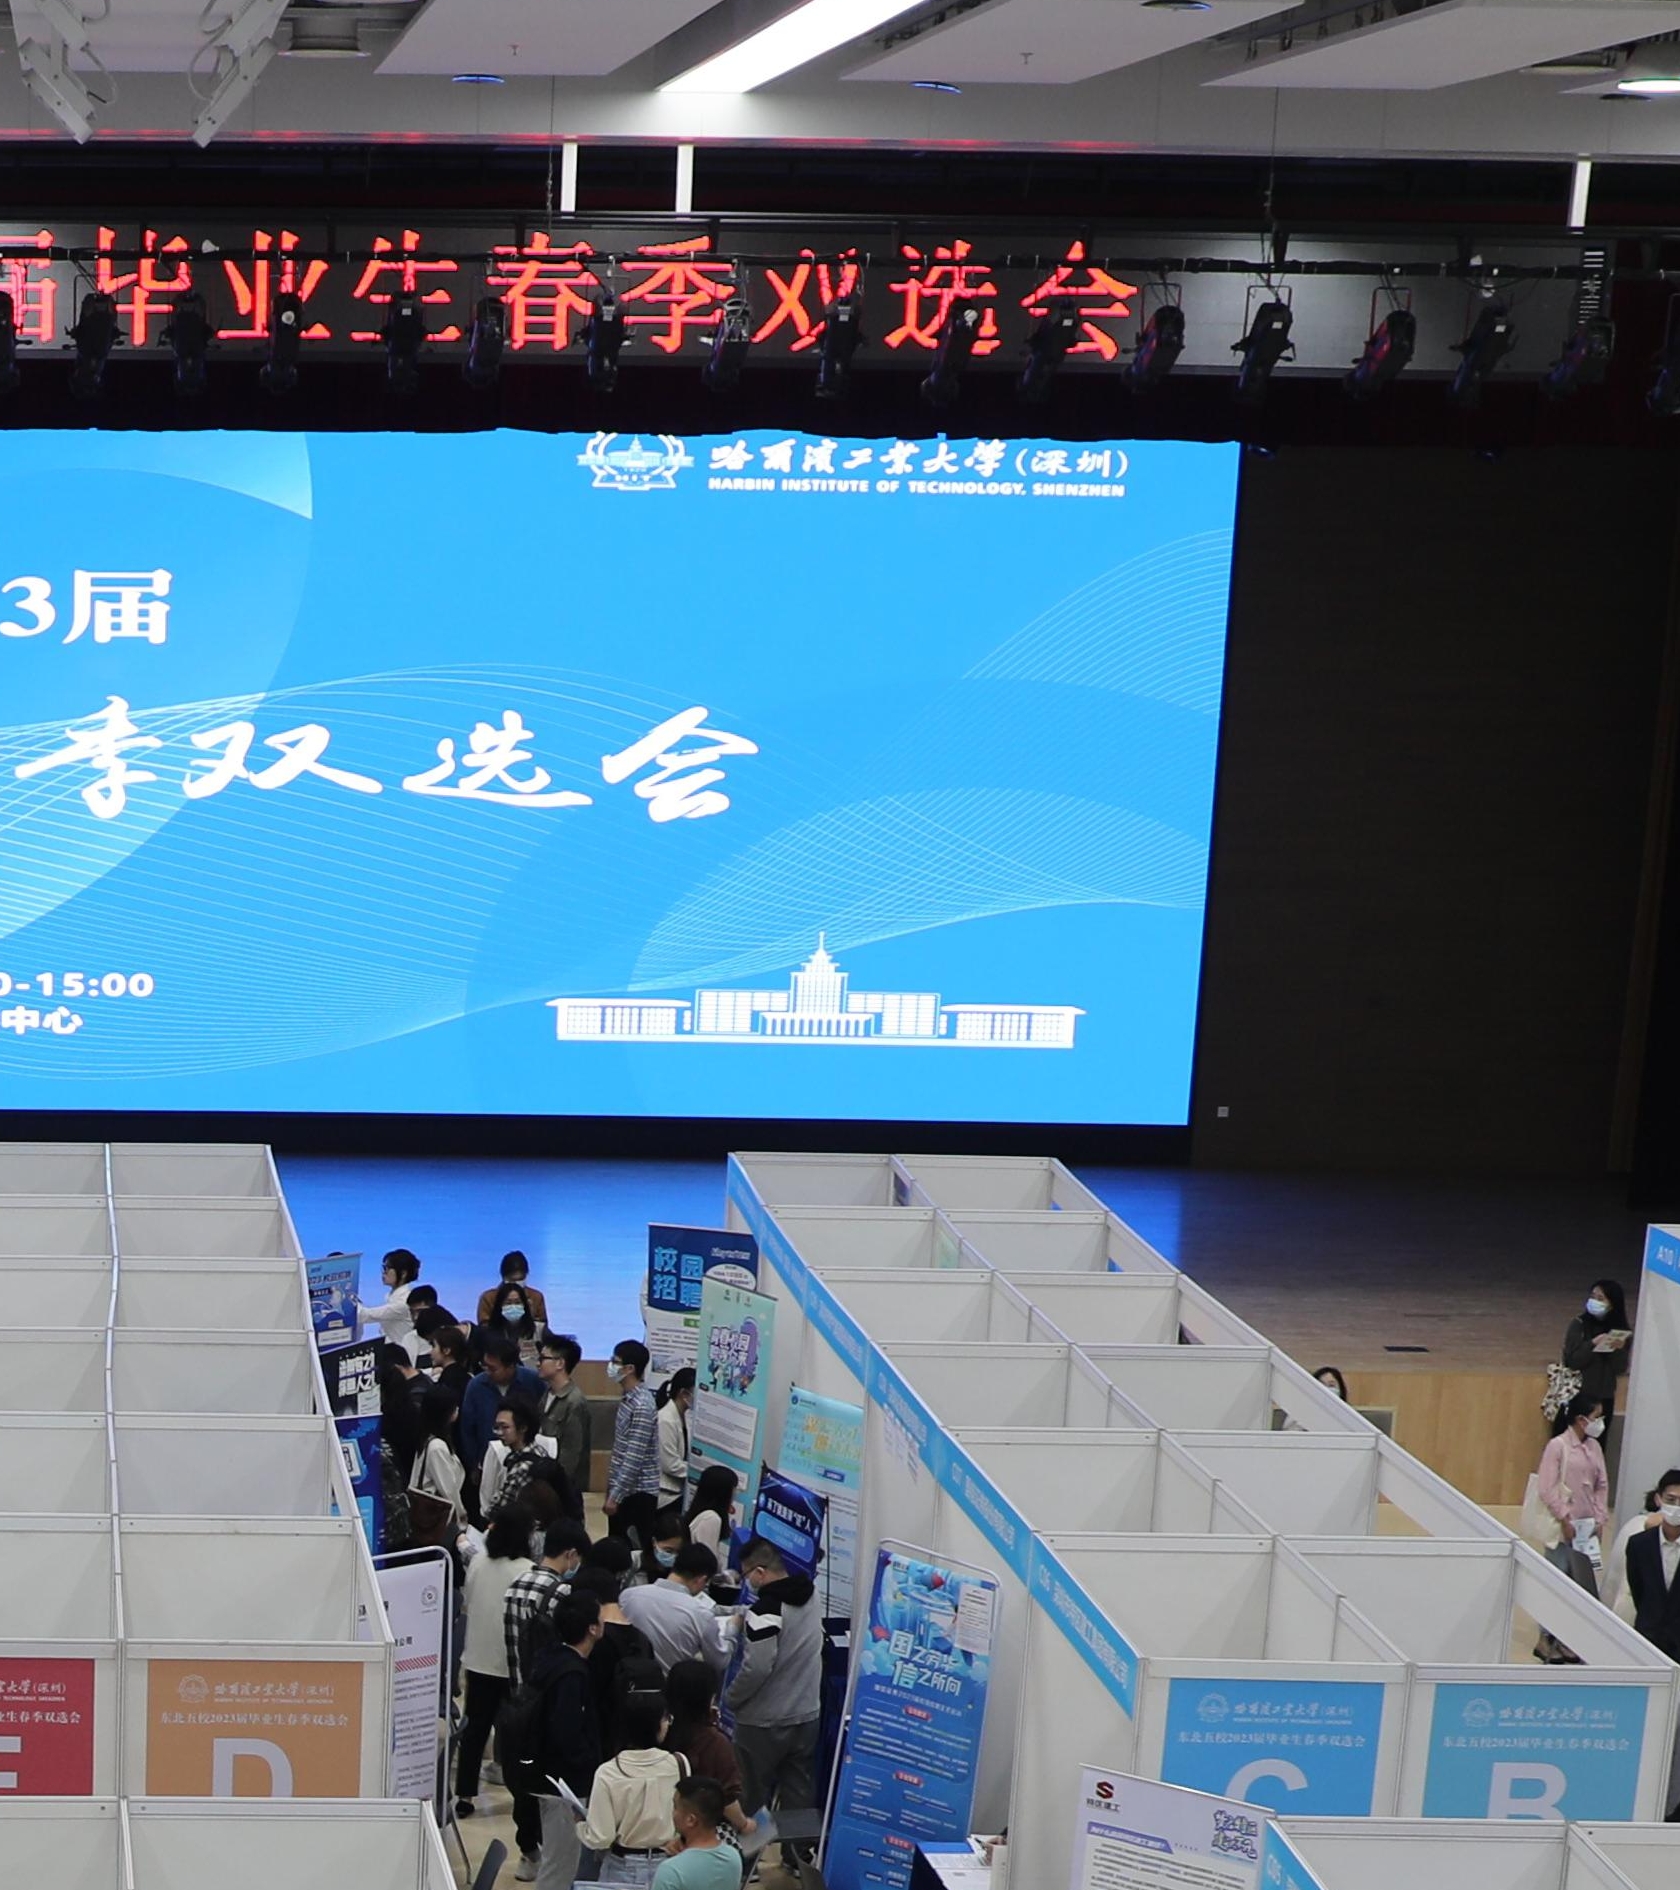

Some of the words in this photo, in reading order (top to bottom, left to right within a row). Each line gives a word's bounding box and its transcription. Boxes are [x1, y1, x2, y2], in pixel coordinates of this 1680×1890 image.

[707, 477, 775, 491] HARBIN
[781, 479, 870, 493] INSTITUTE
[875, 480, 900, 494] OF
[1031, 482, 1126, 498] SHENZHEN
[1177, 1730, 1366, 1748] 东北五校2023届毕业生春季双选会
